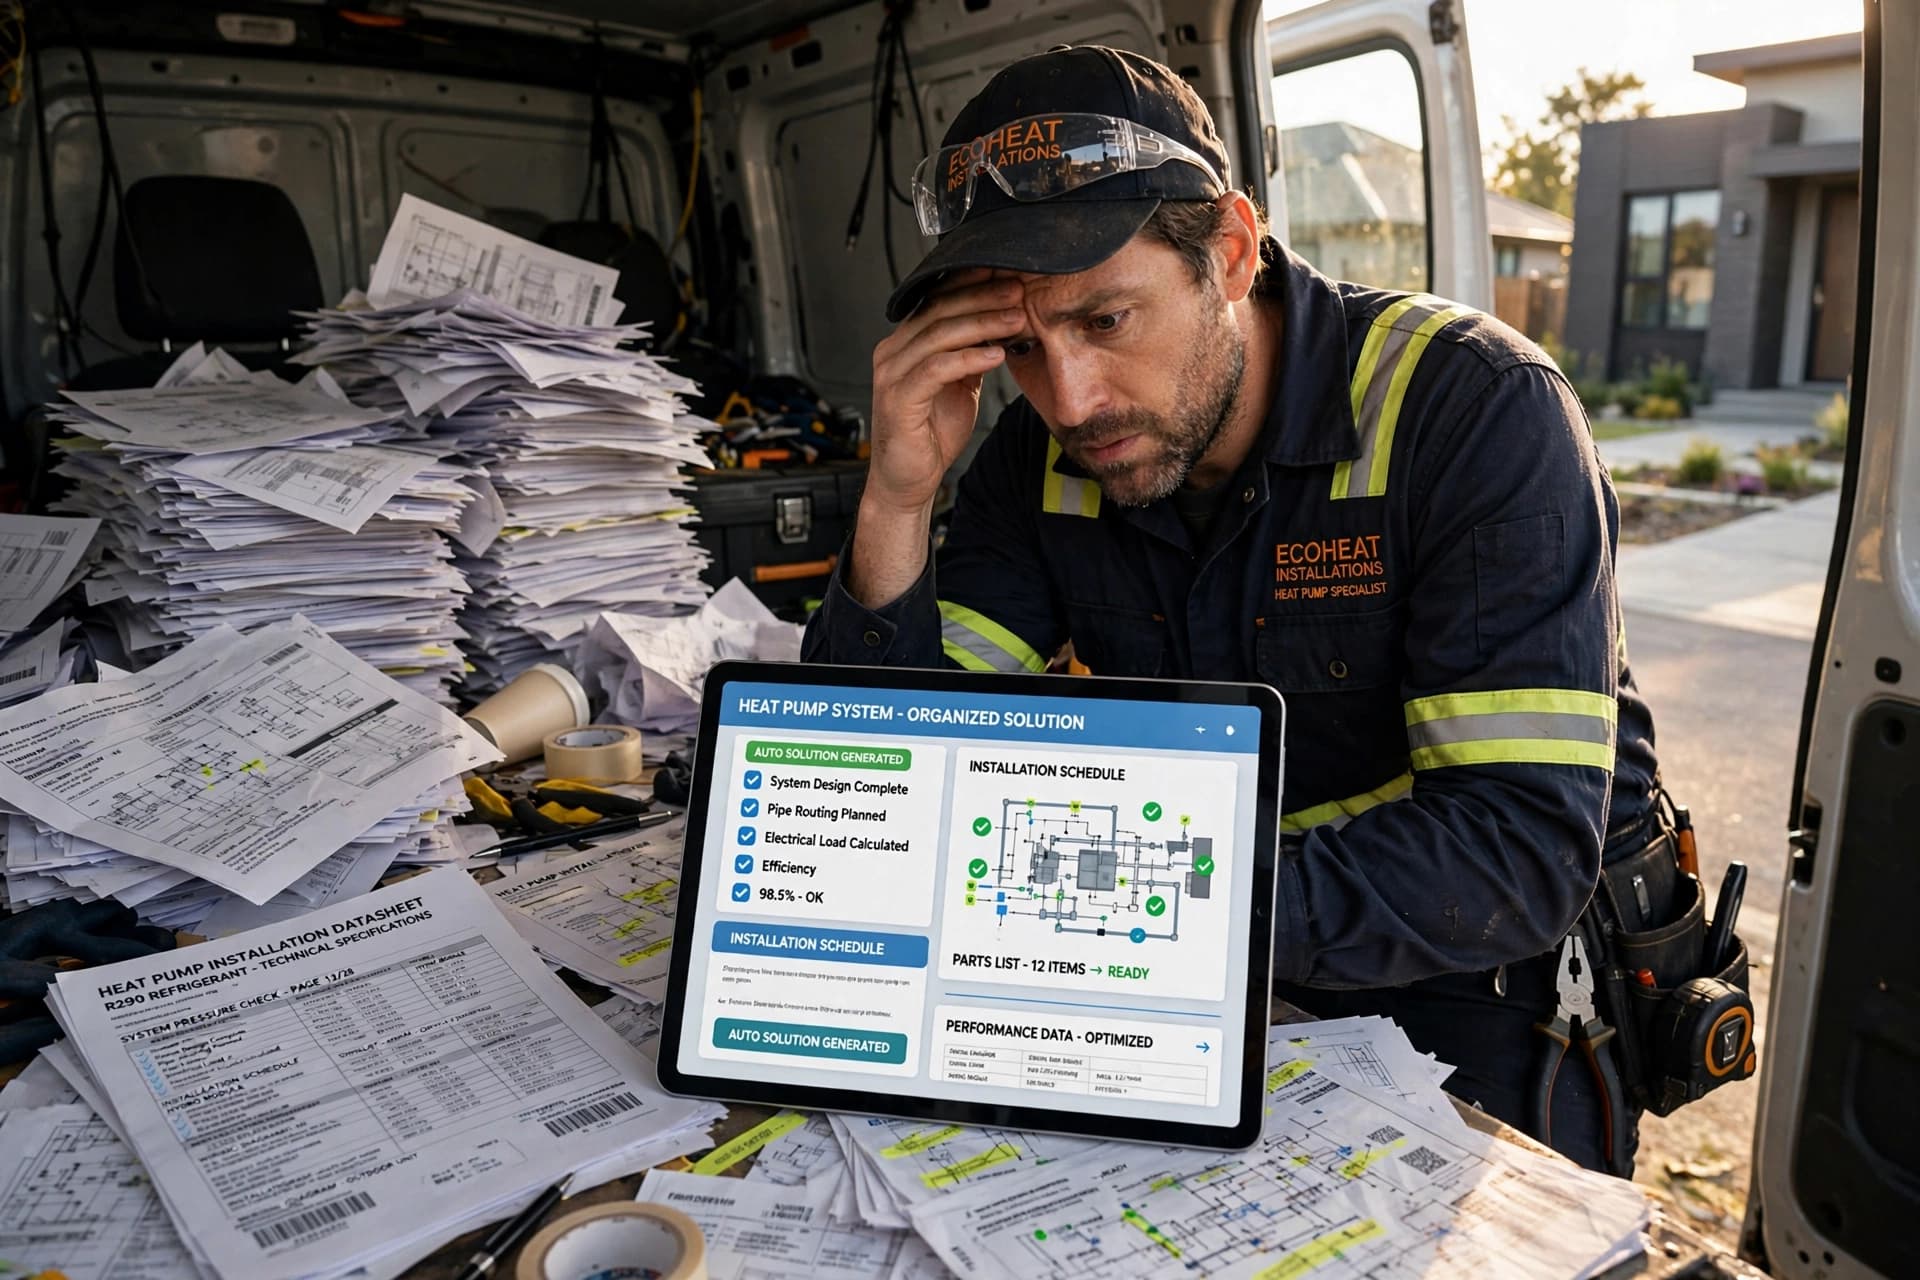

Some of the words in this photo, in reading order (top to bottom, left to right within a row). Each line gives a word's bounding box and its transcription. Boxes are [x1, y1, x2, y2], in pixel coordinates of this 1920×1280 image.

[949, 120, 1063, 175] ECOHEAT
[948, 144, 1061, 192] INSTATIONS
[1276, 535, 1381, 564] ECOHEAT
[1276, 561, 1384, 582] INSTALLATIONS
[1274, 588, 1299, 600] HEAT
[1301, 586, 1329, 599] PUMP
[1330, 582, 1388, 597] SPECIALIST
[738, 698, 780, 715] HEAT
[782, 700, 829, 717] PUMP
[831, 702, 894, 720] SYSTEM
[907, 706, 1000, 726] ORGANIZED
[1003, 712, 1085, 730] SOLUTION
[754, 747, 783, 758] AUTO
[785, 748, 839, 761] SOLUTION
[841, 751, 904, 765] GENERATED
[969, 760, 1057, 777] INSTALLATION
[1060, 765, 1126, 781] SCHEDULE
[770, 775, 811, 790] System
[813, 778, 851, 794] Design
[854, 780, 909, 796] Complete
[767, 803, 792, 818] Pipe
[795, 805, 839, 821] Routing
[841, 808, 886, 822] Planned
[765, 831, 816, 846] Electrical
[819, 835, 847, 848] Load
[850, 837, 909, 852] Calculated
[762, 860, 816, 877] Efficiency
[759, 888, 795, 902] 98.5%
[806, 891, 824, 904] OK
[98, 977, 146, 998] HEAT
[151, 963, 204, 985] PUMP
[207, 927, 330, 970] INSTALLATION
[331, 896, 424, 934] DATASHEET
[730, 932, 817, 950] INSTALLATION
[819, 938, 885, 955] SCHEDULE
[104, 994, 145, 1012] R290
[149, 966, 248, 1001] REFRIGERANT
[259, 942, 335, 970] TECHNICAL
[335, 910, 433, 947] SPECIFICATIONS
[953, 953, 992, 968] PARTS
[995, 957, 1021, 970] LIST
[1031, 960, 1045, 972] 12
[1048, 961, 1086, 975] ITEMS
[1108, 965, 1150, 980] READY
[120, 1023, 171, 1043] SYSTEM
[174, 1004, 238, 1028] PRESSURE
[239, 990, 280, 1009] CHECK
[290, 977, 321, 993] PAGE
[728, 1028, 760, 1042] AUTO
[763, 1032, 820, 1048] SOLUTION
[822, 1037, 890, 1053] GENERATED
[946, 1019, 1038, 1039] PERFORMANCE
[1041, 1028, 1074, 1042] DATA
[1085, 1031, 1153, 1048] OPTIMIZED
